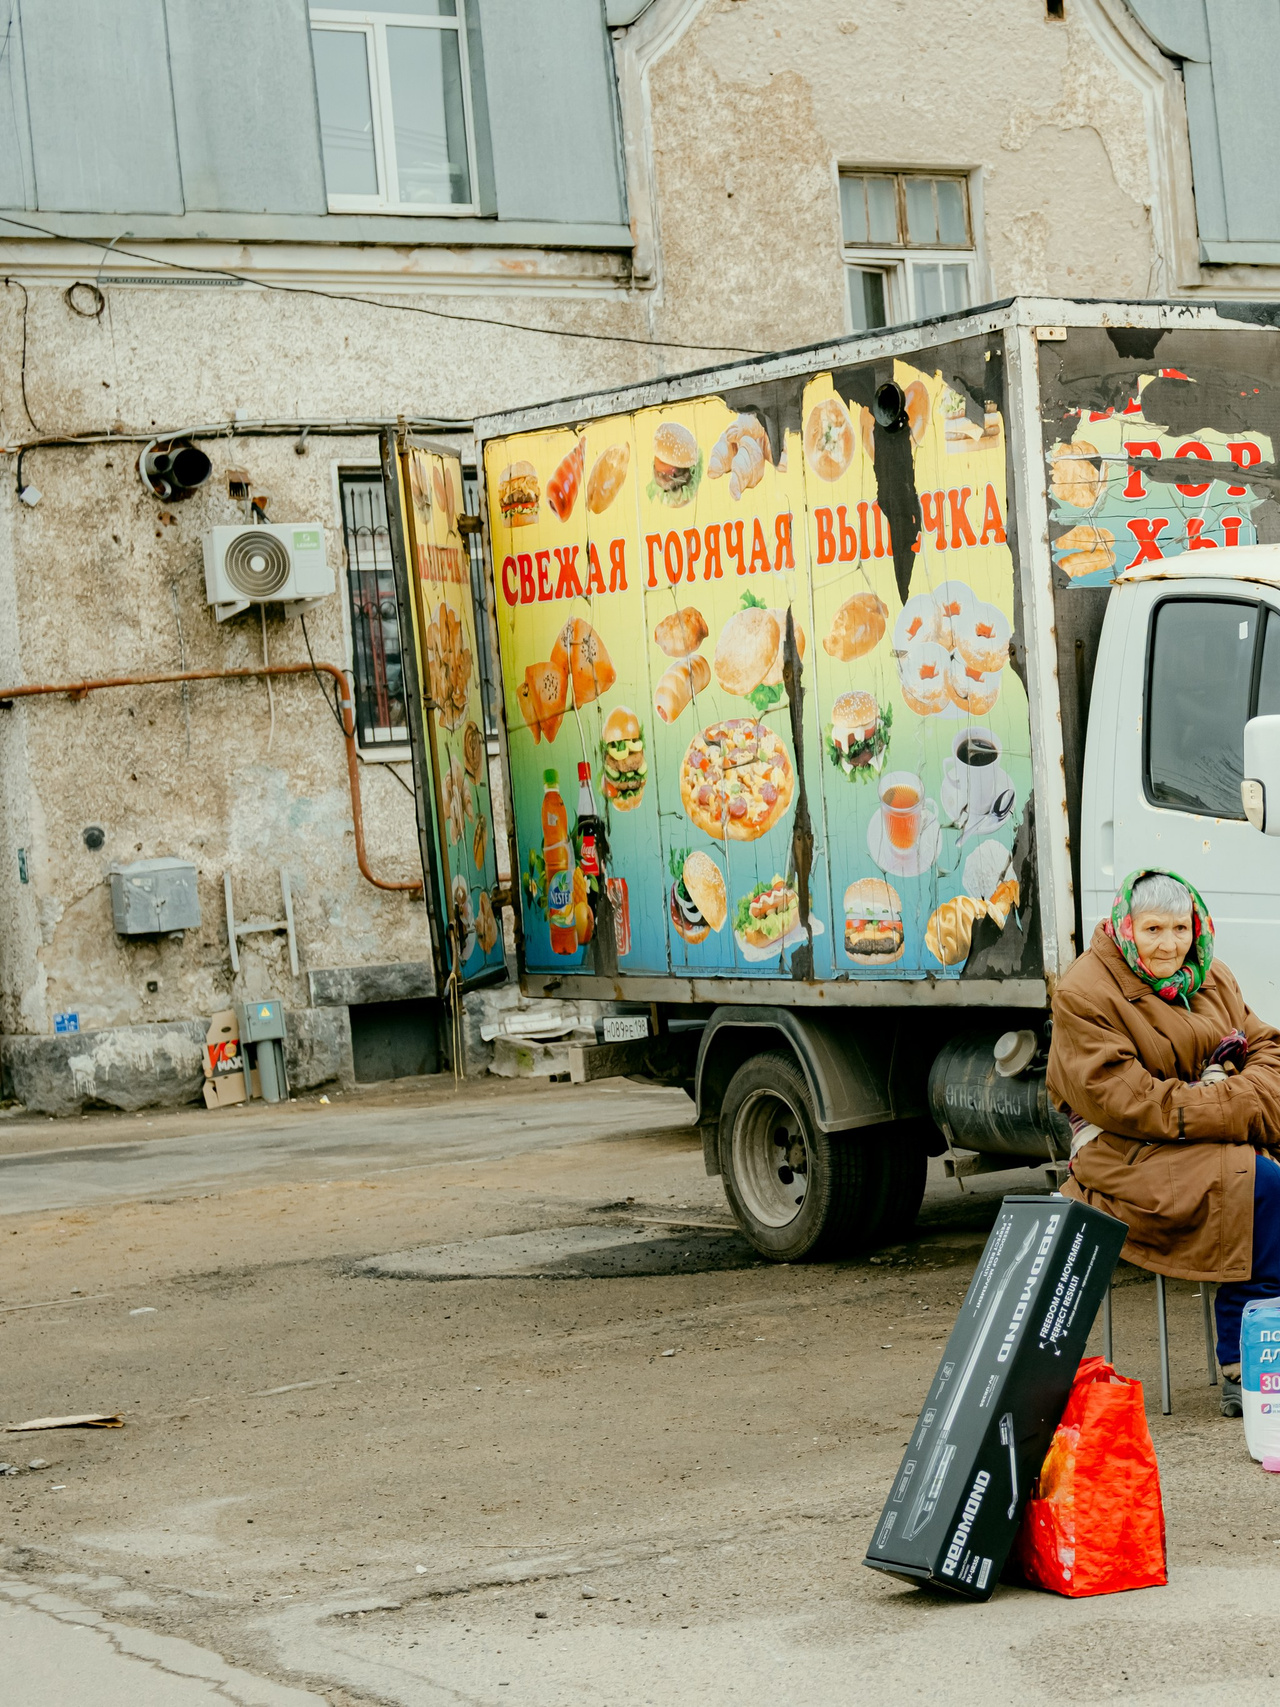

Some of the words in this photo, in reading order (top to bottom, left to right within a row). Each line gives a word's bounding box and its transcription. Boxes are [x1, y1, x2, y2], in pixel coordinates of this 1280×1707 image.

[502, 537, 628, 607] СВЕЖАЯ
[645, 513, 795, 589] ГОРЯЧАЯ
[815, 483, 1007, 567] ВЫПЧКА
[550, 891, 572, 905] NESTE
[1040, 1296, 1061, 1338] FREEDOM
[1055, 1282, 1065, 1298] OF
[1060, 1232, 1084, 1283] MOVEMENT
[1049, 1307, 1068, 1343] PERFECT
[1062, 1275, 1080, 1307] RESULT!
[941, 1470, 991, 1576] REDMOND
